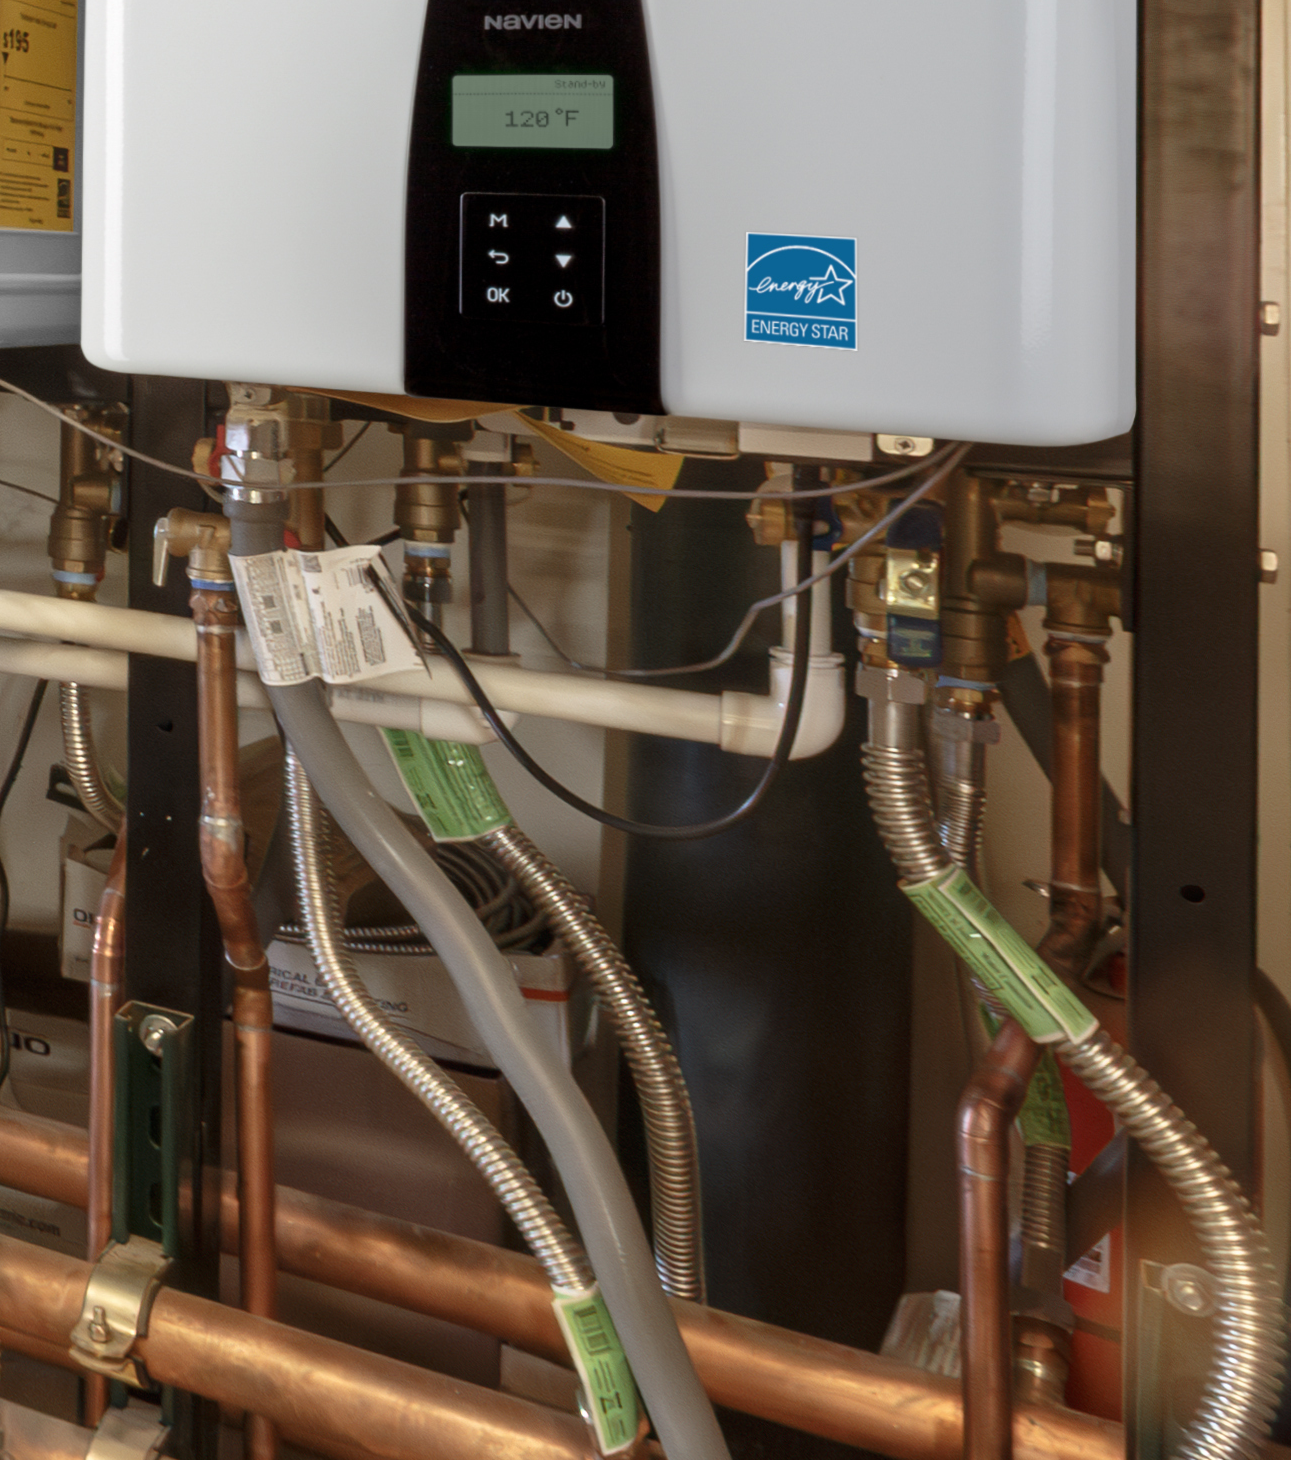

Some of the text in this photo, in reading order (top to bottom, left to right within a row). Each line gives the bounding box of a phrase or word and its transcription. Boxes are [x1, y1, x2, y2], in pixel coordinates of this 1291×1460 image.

[489, 214, 508, 227] M
[486, 287, 510, 303] OK
[748, 276, 821, 301] energy
[751, 319, 849, 342] ENERGY STAR
